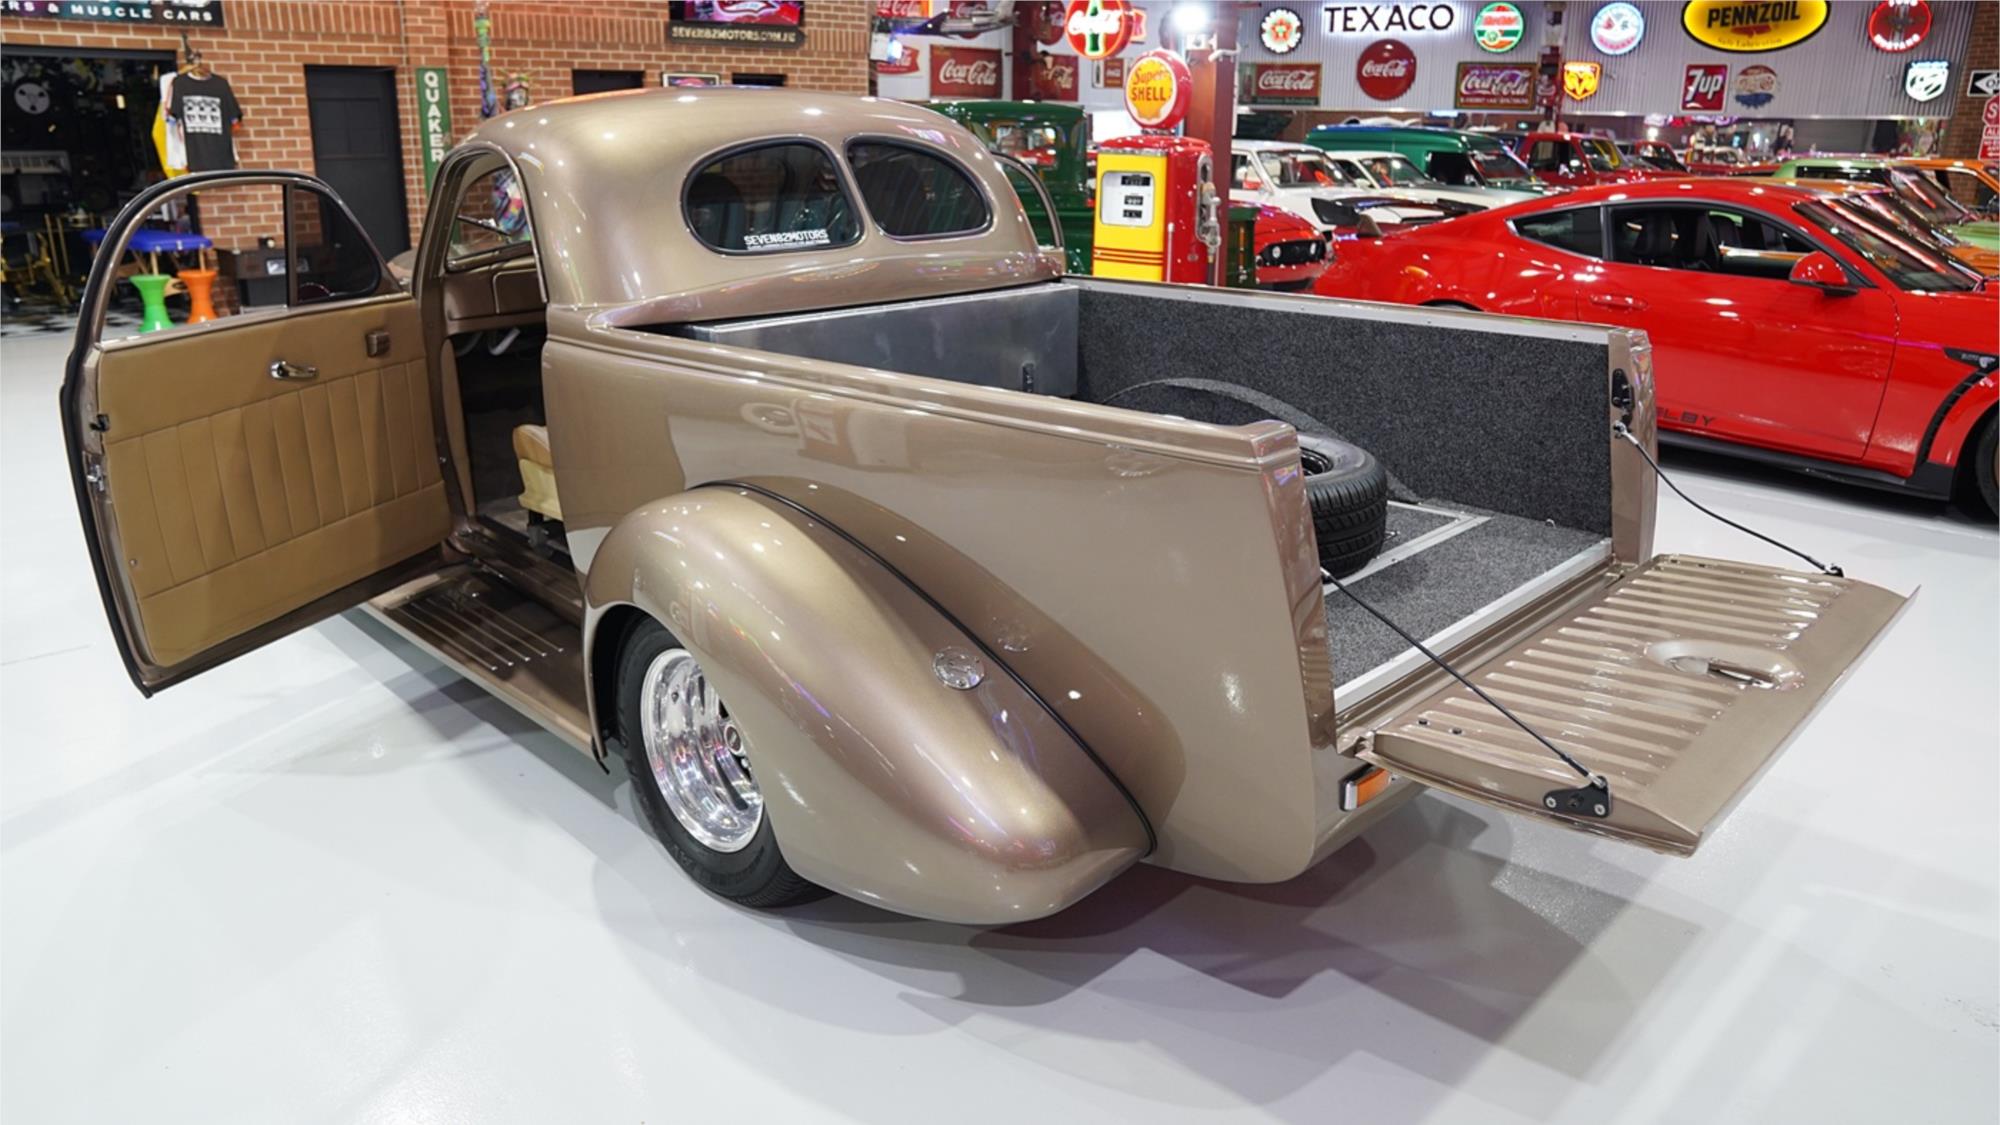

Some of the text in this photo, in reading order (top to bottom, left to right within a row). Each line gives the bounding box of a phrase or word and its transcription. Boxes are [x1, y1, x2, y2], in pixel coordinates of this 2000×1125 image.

[48, 4, 59, 14] &
[71, 4, 152, 19] MUSCLE
[163, 10, 213, 22] CARS
[1324, 4, 1454, 32] TEXACO
[1707, 0, 1800, 28] PENNZOIL
[1131, 87, 1167, 101] SHELL
[424, 71, 445, 162] QUAKER
